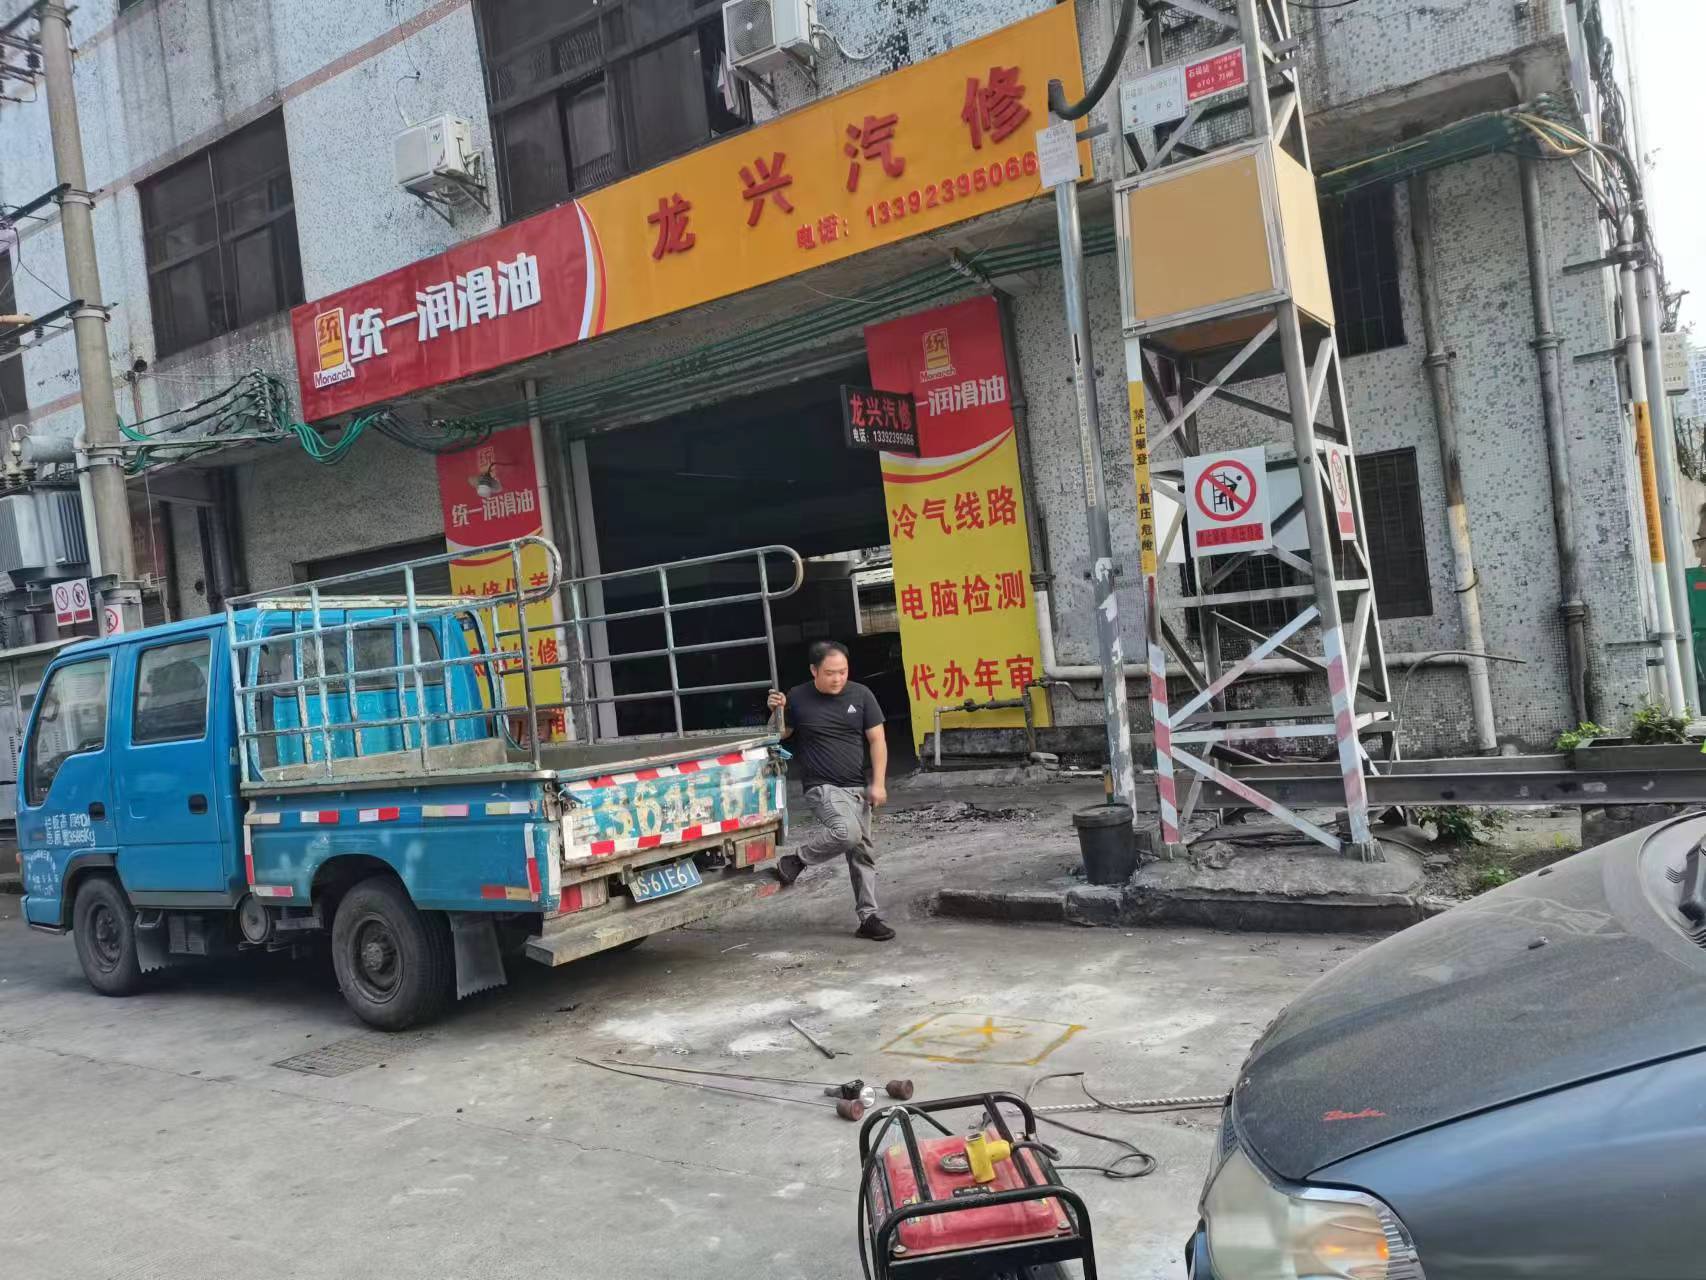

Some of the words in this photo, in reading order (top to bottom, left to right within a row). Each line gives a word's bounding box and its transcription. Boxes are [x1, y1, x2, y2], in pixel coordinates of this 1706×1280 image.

[647, 65, 1031, 260] 龙兴汽修
[866, 151, 1039, 228] 13392395066
[348, 252, 542, 363] 统一润滑油
[314, 364, 353, 388] Monarch
[849, 391, 912, 431] 龙兴汽修
[451, 487, 536, 528] 统一润滑油
[891, 485, 1017, 540] 冷气线路
[900, 570, 1027, 620] 电脑检测
[911, 653, 1034, 701] 代办年审
